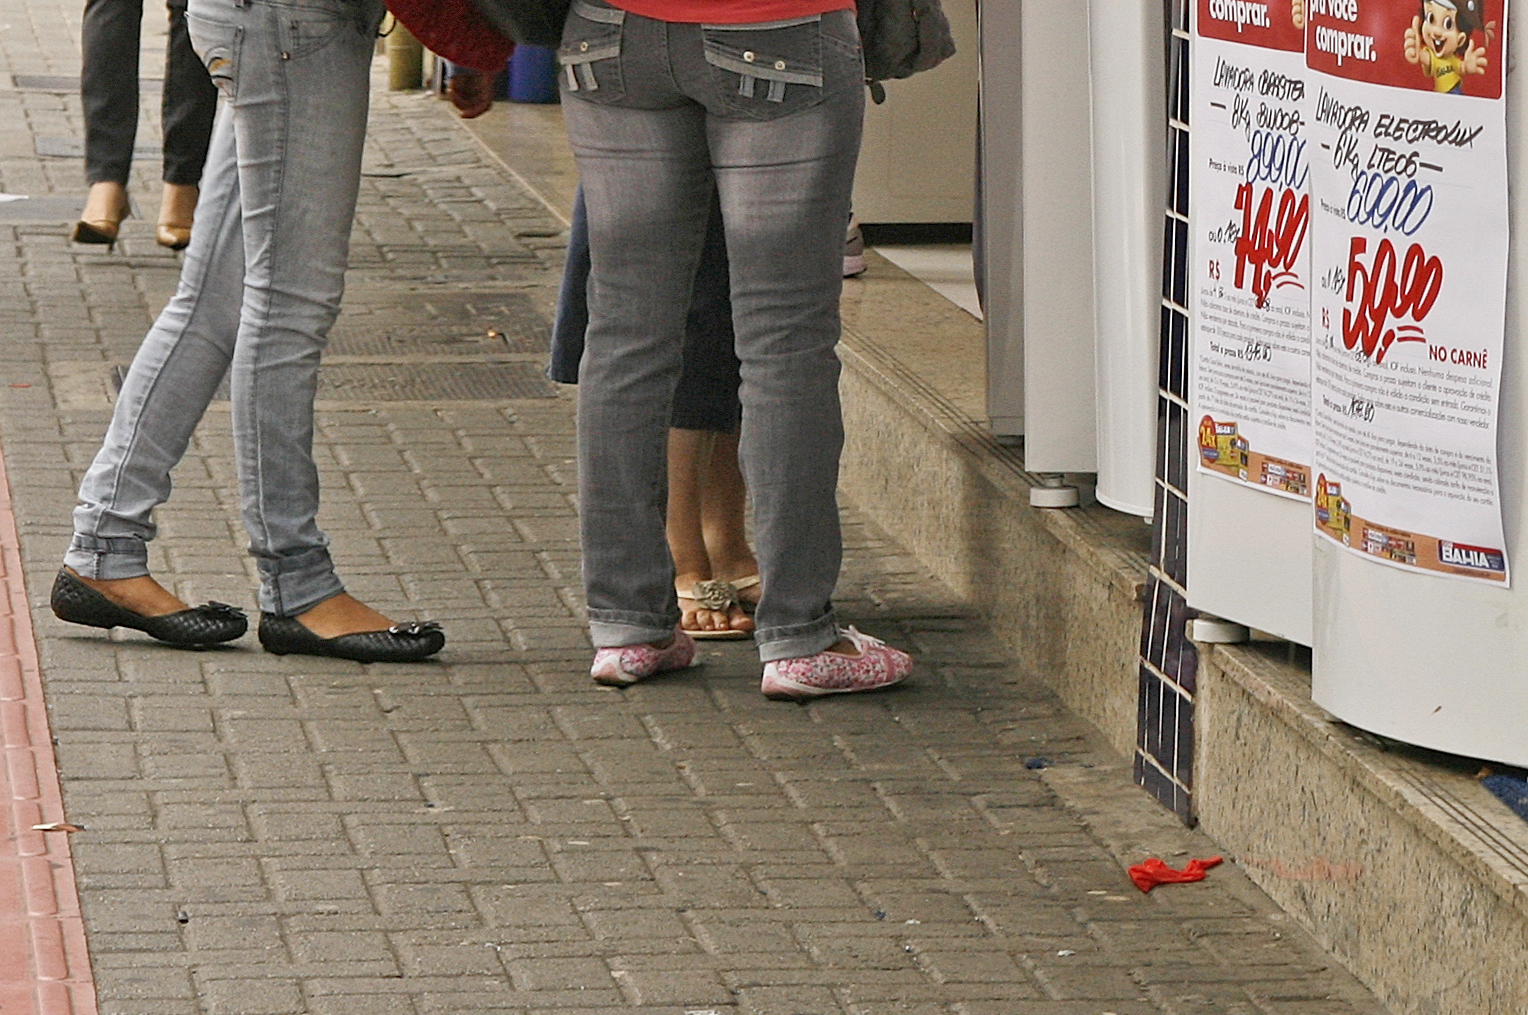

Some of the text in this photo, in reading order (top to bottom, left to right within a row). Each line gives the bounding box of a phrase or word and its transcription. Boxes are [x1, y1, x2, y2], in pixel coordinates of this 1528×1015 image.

[1316, 25, 1377, 66] comprar.
[1316, 85, 1483, 148] LAVADORA ELECTROLUX
[1209, 259, 1221, 281] R$
[1429, 345, 1488, 369] NO CARNÊ
[1442, 544, 1491, 569] BAHIA
